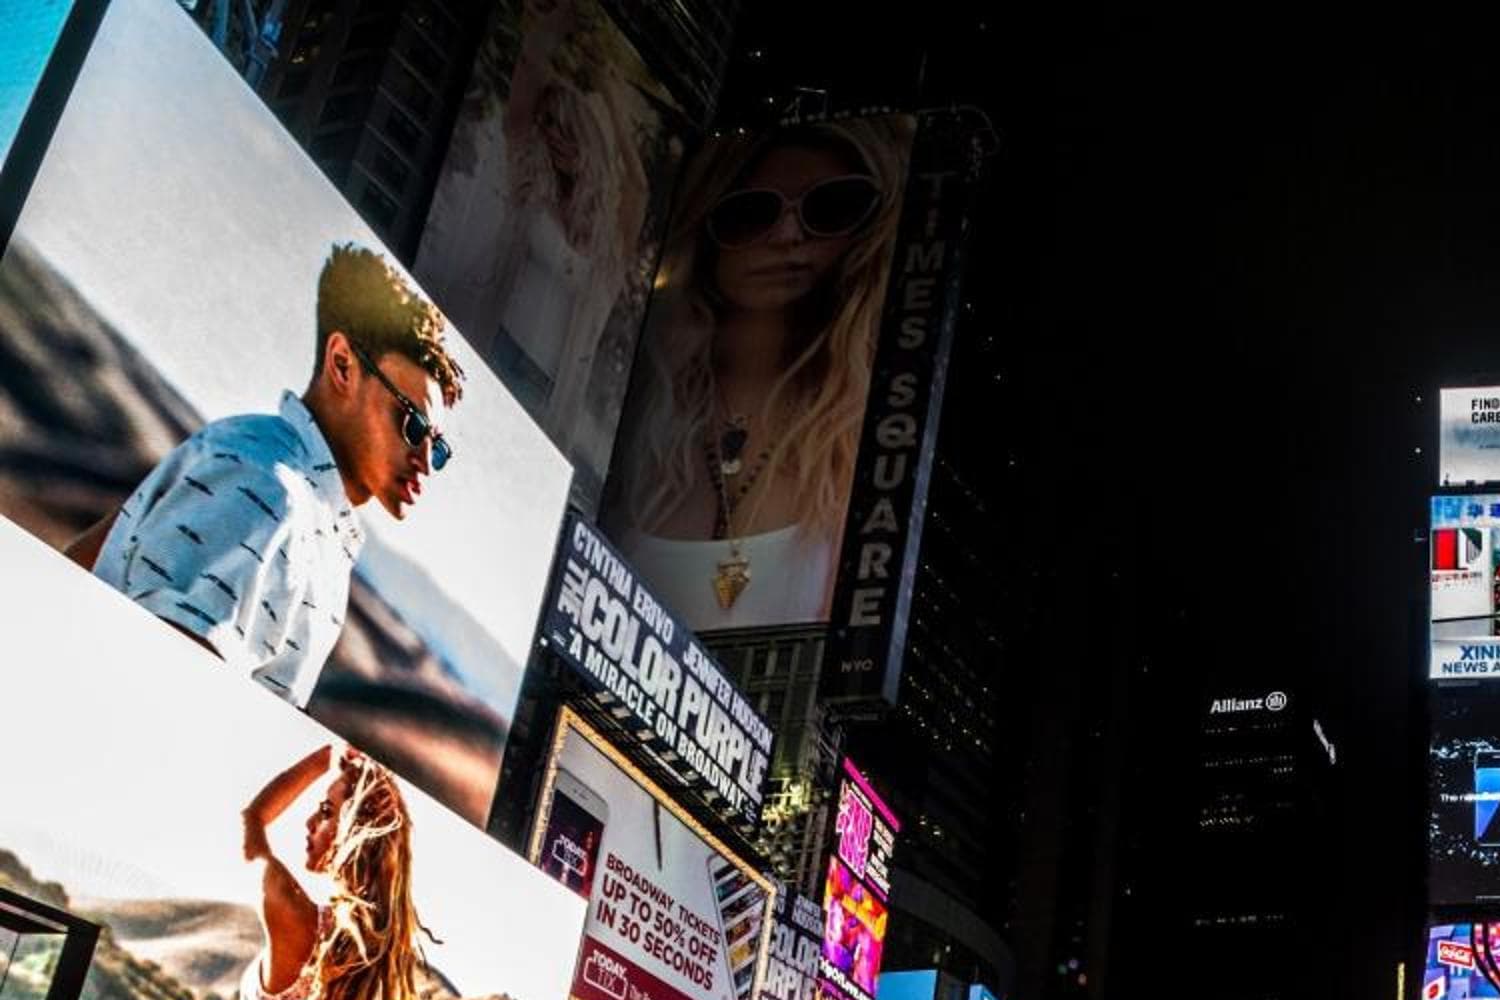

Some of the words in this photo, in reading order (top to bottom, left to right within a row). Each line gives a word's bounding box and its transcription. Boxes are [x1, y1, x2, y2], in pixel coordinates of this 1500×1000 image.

[901, 171, 959, 349] TIMES
[1471, 398, 1500, 410] FIND
[849, 373, 917, 628] SQUARE
[573, 521, 633, 601] CYNTHIA
[633, 583, 675, 645] ERIVO
[579, 577, 683, 718] COLOR
[678, 674, 767, 805] PURPLE
[584, 643, 653, 725] MIRACLE
[656, 712, 677, 747] ON
[1210, 698, 1263, 714] Allianz
[1442, 661, 1488, 673] NEWS
[602, 876, 625, 903] UP
[630, 892, 650, 922] TO
[654, 911, 685, 947] 50%
[690, 935, 718, 965] OFF
[606, 853, 675, 910] BROADWAY
[679, 905, 720, 945] TICKETS
[592, 950, 628, 979] TODAY
[597, 900, 616, 928] IN
[619, 915, 641, 943] 30
[643, 928, 713, 991] SECONDS
